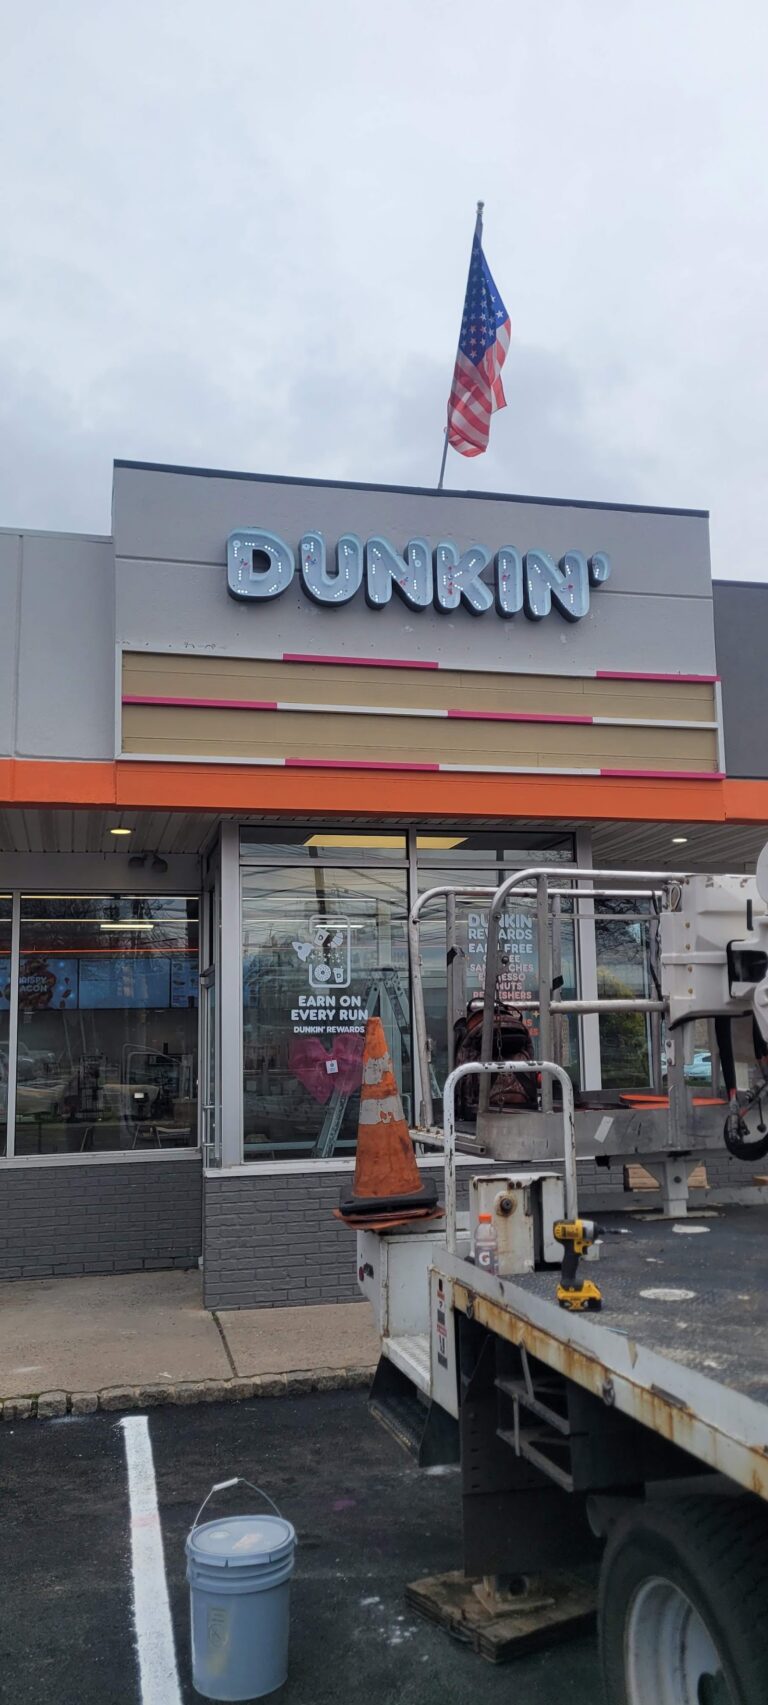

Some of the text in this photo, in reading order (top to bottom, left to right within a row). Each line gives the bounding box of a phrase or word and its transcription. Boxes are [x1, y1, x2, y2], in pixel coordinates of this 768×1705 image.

[227, 526, 611, 622] DUNKIN'
[468, 929, 533, 940] REARDS
[468, 943, 533, 953] EA FREE
[470, 964, 534, 972] SACHES
[478, 973, 526, 981] EESSO
[19, 984, 47, 992] ACON
[482, 982, 522, 990] NUTS
[473, 991, 532, 999] RESHERS
[298, 995, 361, 1007] EARN ON
[291, 1009, 369, 1021] EVERY RUN
[479, 1251, 490, 1266] G
